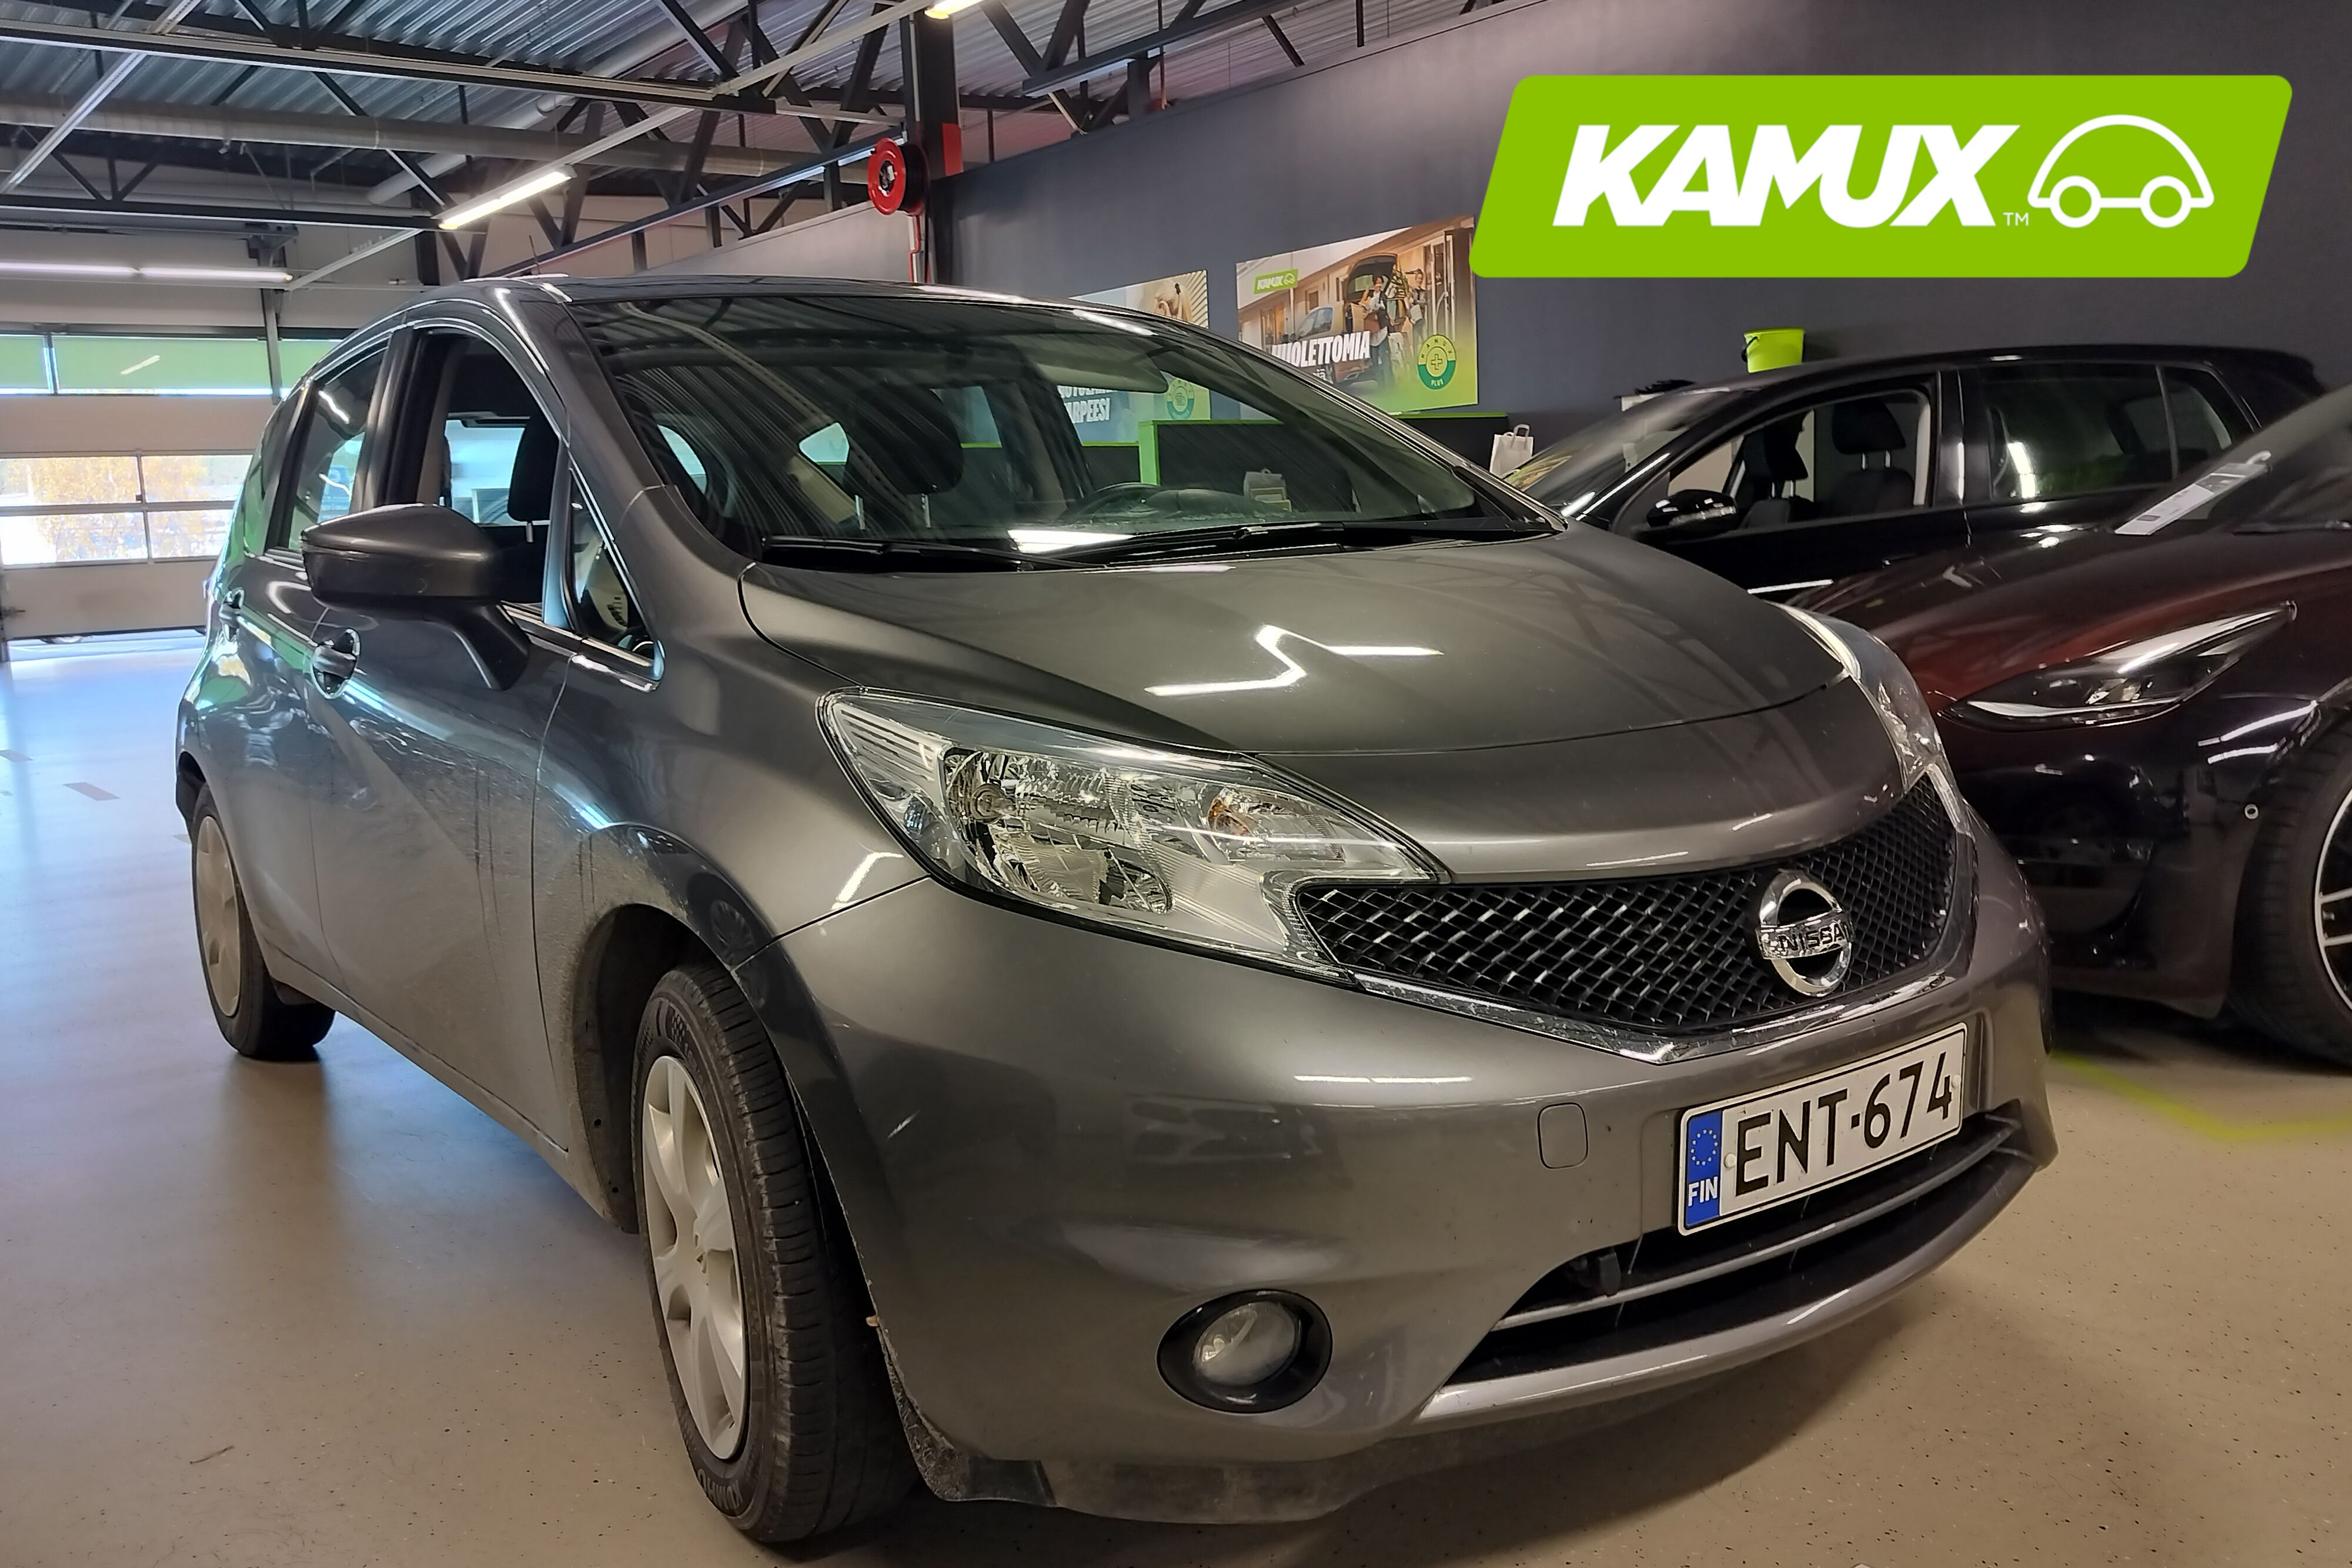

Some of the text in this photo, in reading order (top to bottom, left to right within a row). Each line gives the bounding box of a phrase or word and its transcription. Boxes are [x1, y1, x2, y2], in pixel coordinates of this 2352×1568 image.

[1064, 397, 1110, 424] ARPEESI
[1735, 1051, 1953, 1196] ENT-674
[1687, 1176, 1718, 1207] FIN
